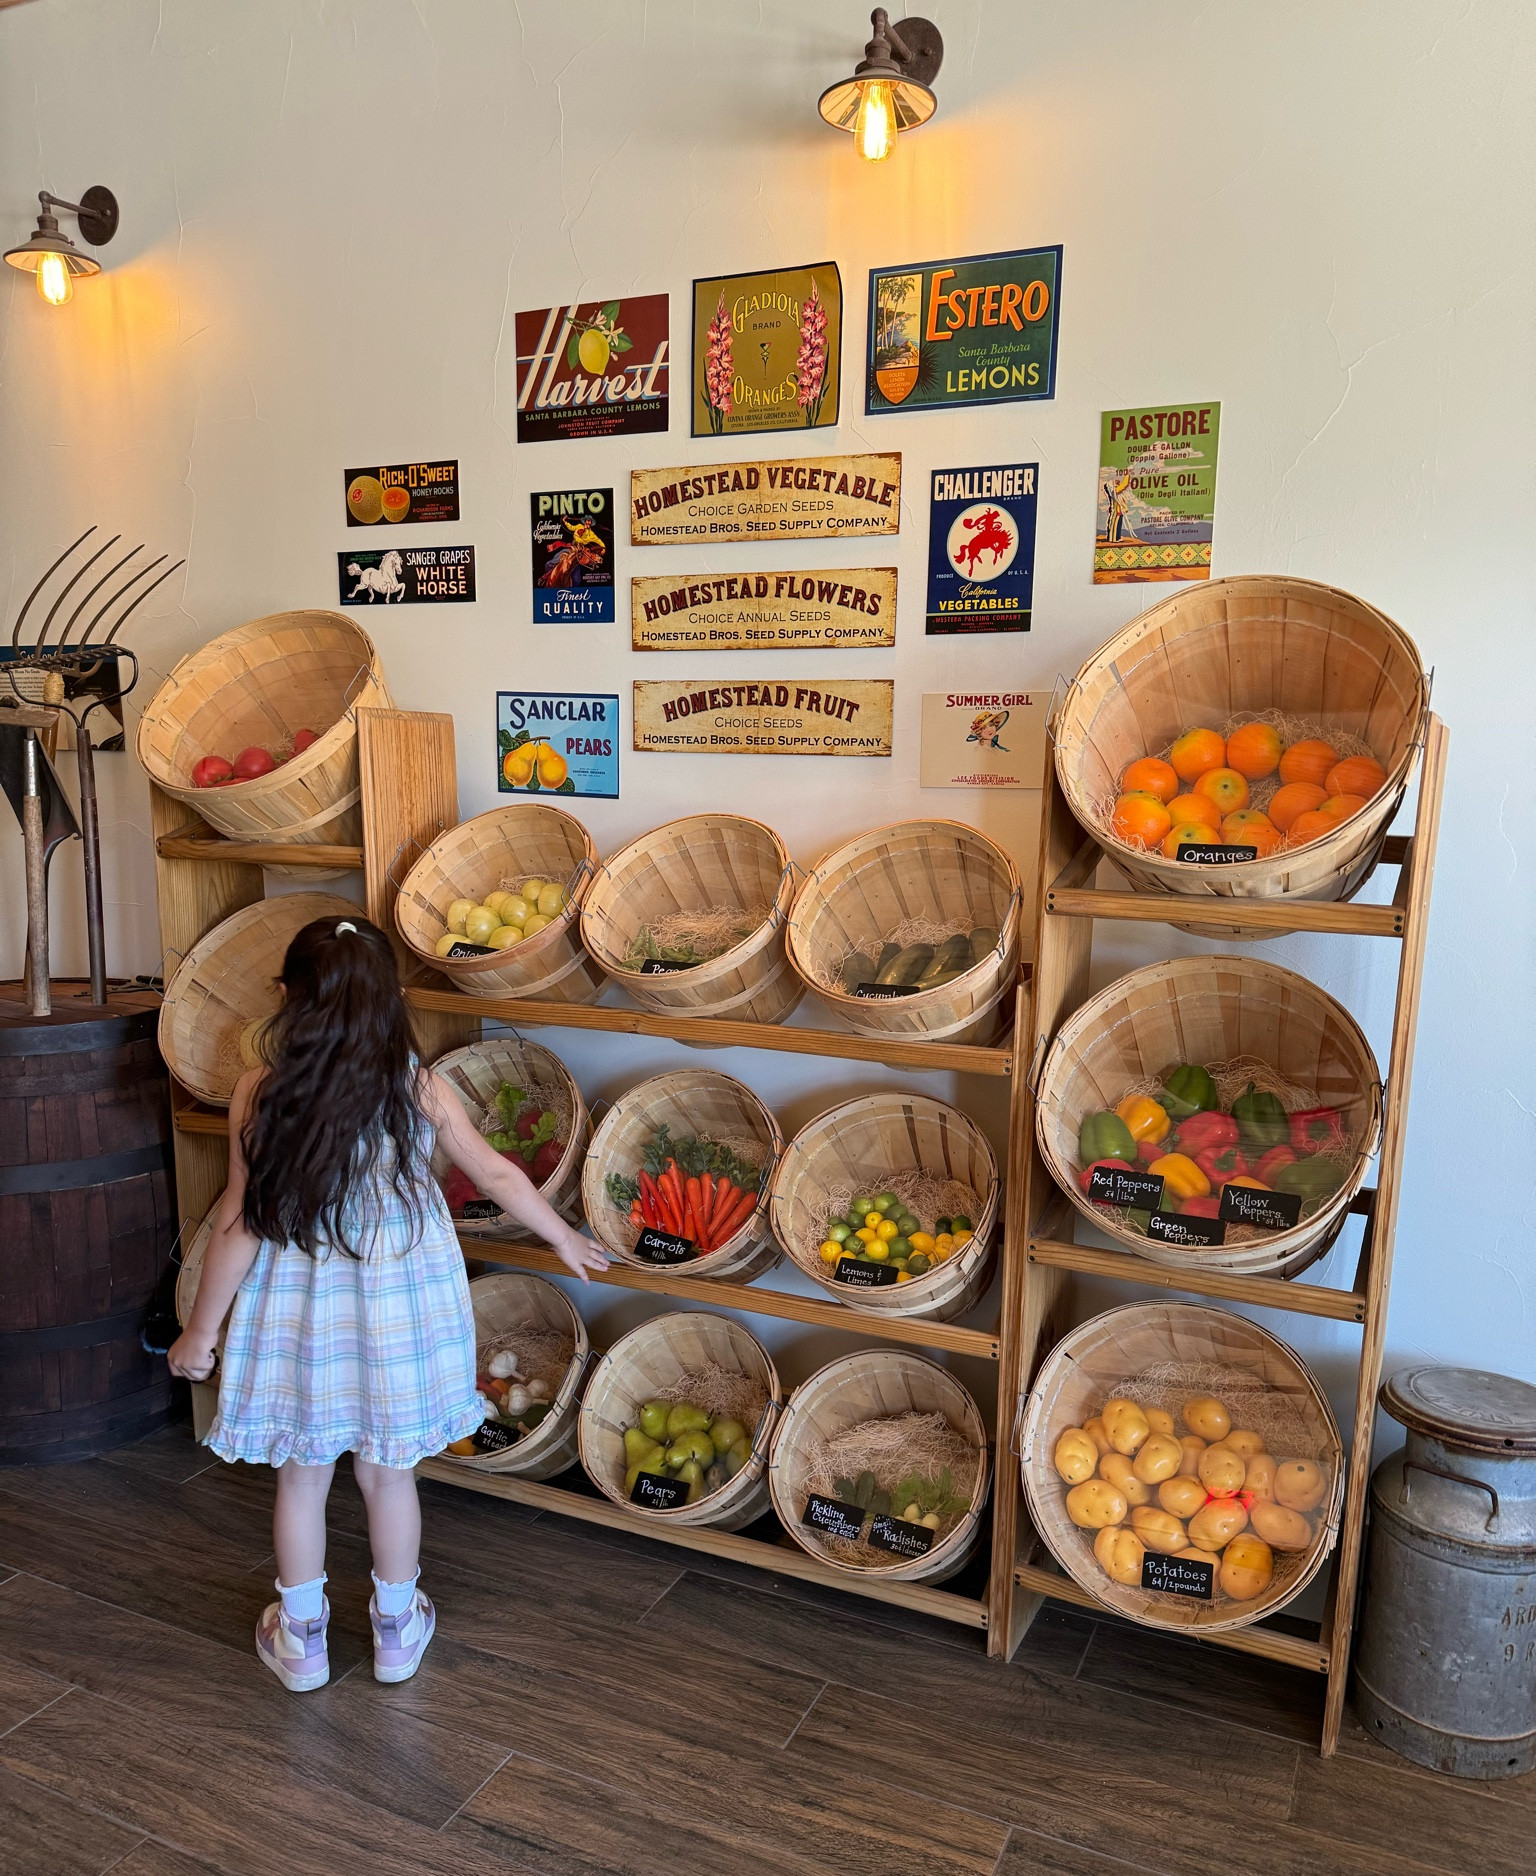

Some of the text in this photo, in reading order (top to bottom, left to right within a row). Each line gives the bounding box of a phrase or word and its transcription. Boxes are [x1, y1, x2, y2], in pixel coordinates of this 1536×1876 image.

[732, 291, 800, 333] GLADIOLA
[926, 269, 1049, 341] ESTERO
[752, 320, 781, 331] BRAND
[517, 304, 669, 410] Harvest
[958, 343, 1031, 358] Santa Barbara
[975, 355, 1011, 366] County
[946, 362, 1040, 393] LEMONS
[733, 371, 797, 408] ORANGES
[525, 402, 661, 422] SANTA BARBARA COUNTY LEMONS
[1110, 409, 1211, 442] PASTORE
[1127, 441, 1191, 453] DOUBLE GALLON
[1139, 466, 1160, 475] Pure
[934, 468, 1035, 501] CHALLENGER
[1130, 473, 1199, 490] OLIVE OIL
[412, 486, 454, 497] HONEY ROCKS
[633, 466, 897, 520] HOMESTEAD VEGETABLE
[1158, 490, 1177, 499] Degli
[538, 491, 605, 516] PINTO
[688, 500, 834, 517] CHOICE GARDEN SEEDS
[640, 516, 888, 537] HOMESTEAD BROS. SEED SUPPLY COMPANY
[1140, 516, 1162, 524] PASTORE
[1179, 513, 1204, 522] COMPANY
[406, 550, 470, 566] SANGER GRAPES
[415, 566, 466, 580] WHITE
[417, 581, 467, 596] HORSE
[556, 589, 592, 602] Finest
[959, 582, 997, 599] California
[642, 576, 882, 622] HOMESTEAD FLOWERS
[939, 598, 1019, 611] VEGETABLES
[543, 602, 603, 616] QUALITY
[688, 610, 831, 624] CHOICE ANNUAL SEEDS
[641, 627, 884, 641] HOMESTEAD BROS. SEED SUPPLY COMPANY
[662, 685, 860, 723] HOMESTEAD FRUIT
[945, 693, 1033, 708] SUMMER GIRL
[509, 698, 606, 729] SANCLAR
[714, 716, 803, 728] CHOICE SEEDS
[566, 737, 612, 756] PEARS
[643, 733, 883, 748] HOMESTEAD BROS. SEED SUPPLY COMPANY
[1184, 850, 1254, 864] Oranges
[1092, 1172, 1161, 1194] Red Peppers
[1228, 1190, 1270, 1207] Yellow
[1240, 1205, 1282, 1222] Peppers
[1150, 1216, 1187, 1234] Green
[644, 1234, 686, 1255] Carrots
[1164, 1229, 1210, 1244] Peppers
[841, 1264, 874, 1278] Lemons
[847, 1276, 872, 1286] Limes
[480, 1425, 508, 1442] Garlic
[641, 1479, 677, 1498] Pears
[811, 1500, 845, 1520] Pickling
[812, 1512, 860, 1533] Cucumbers
[883, 1529, 929, 1551] Radishes
[1145, 1561, 1208, 1581] Potatoes
